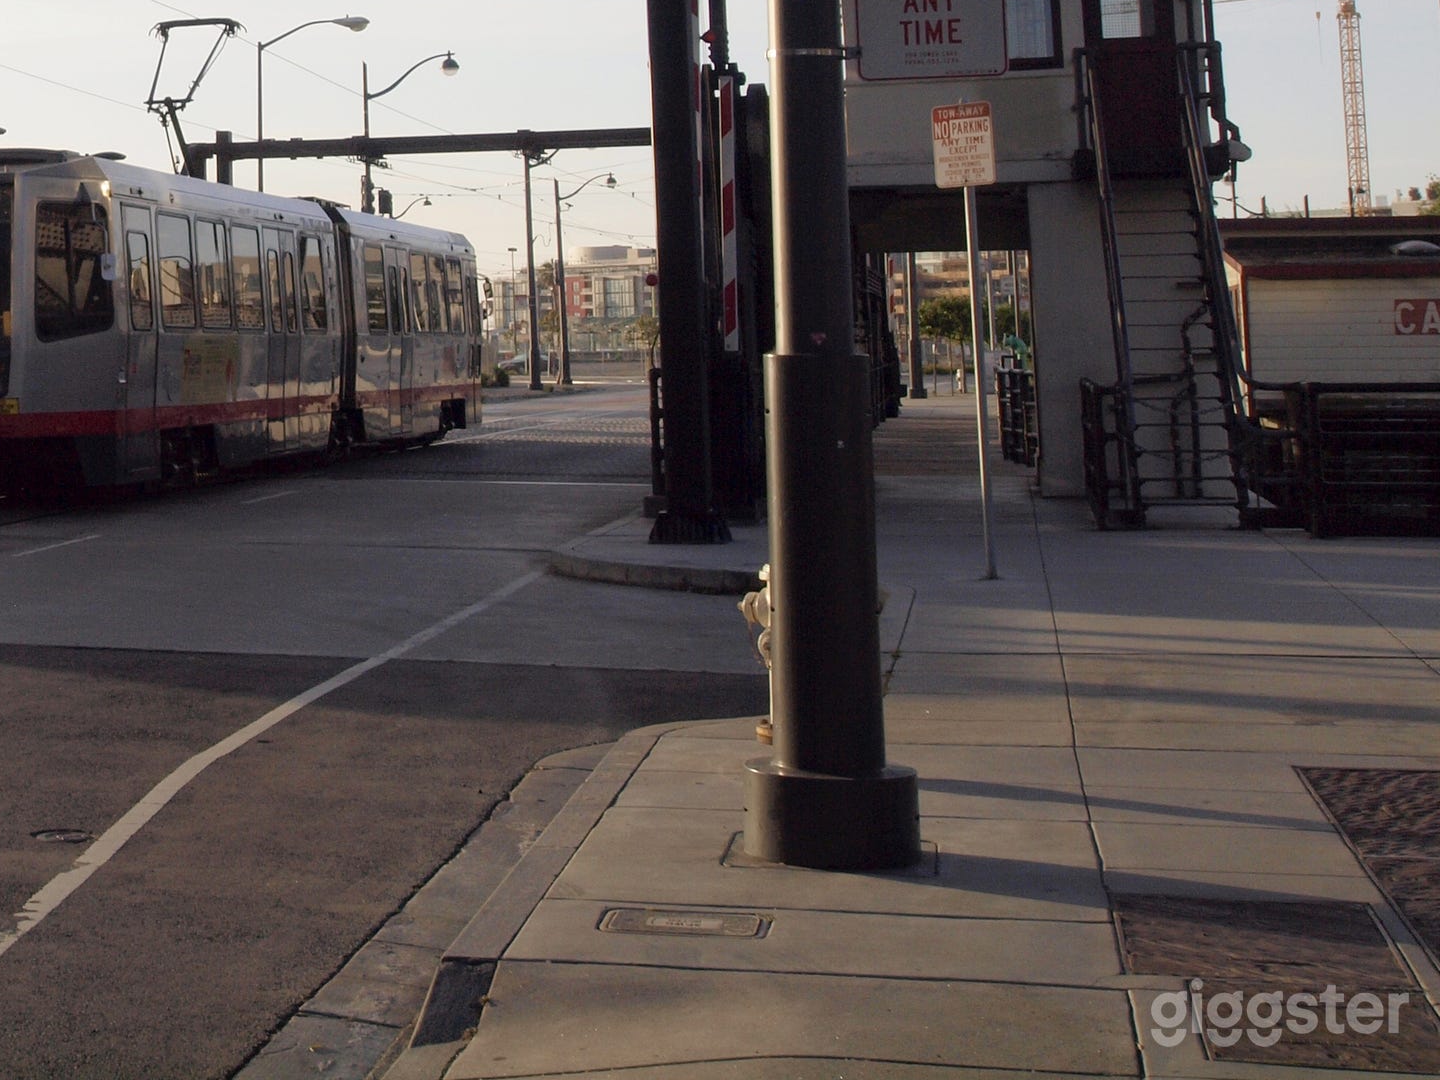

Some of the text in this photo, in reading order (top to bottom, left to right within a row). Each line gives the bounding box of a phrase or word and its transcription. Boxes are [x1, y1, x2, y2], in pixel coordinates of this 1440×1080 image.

[900, 19, 962, 45] TIME
[937, 106, 983, 119] TOW-AWAY
[934, 119, 989, 139] NO PARKING
[941, 135, 985, 147] ANY TIME
[949, 145, 978, 154] EXCEPT
